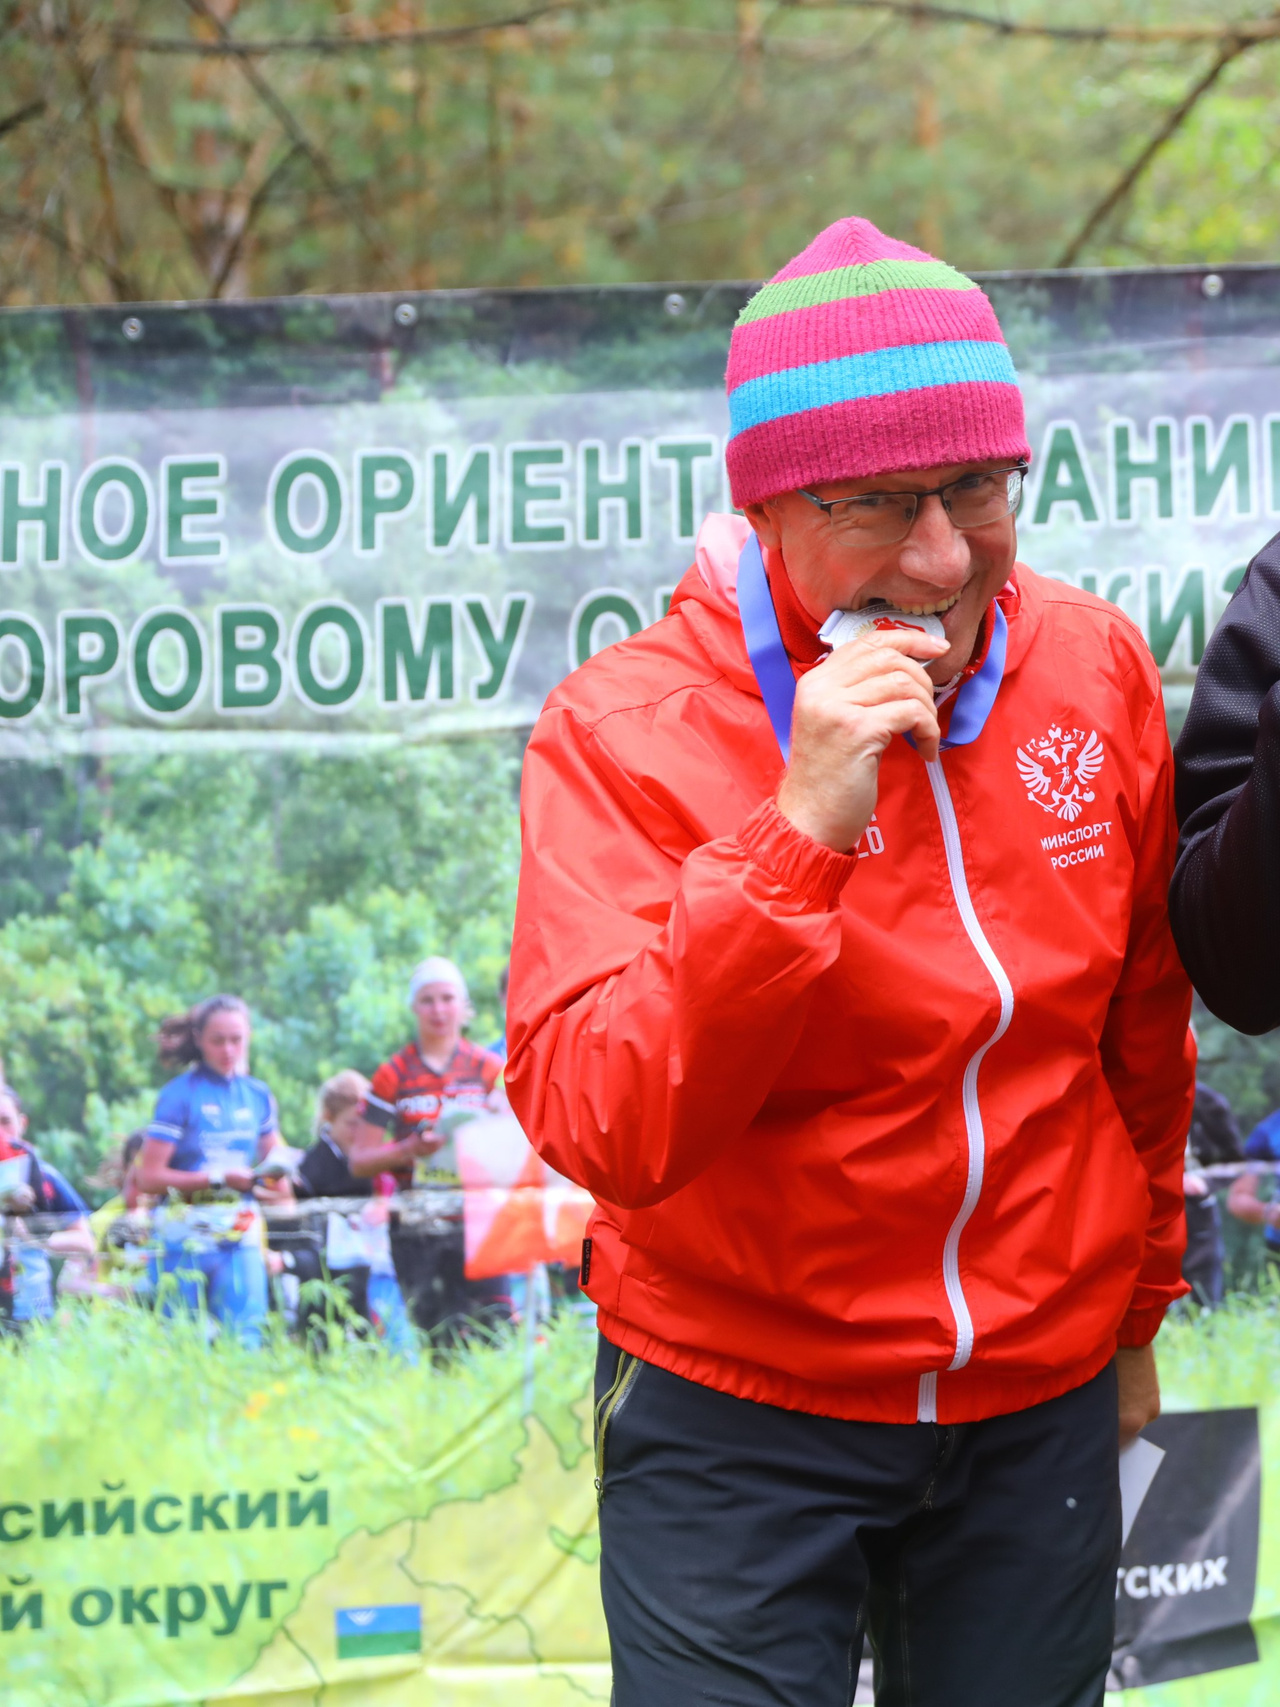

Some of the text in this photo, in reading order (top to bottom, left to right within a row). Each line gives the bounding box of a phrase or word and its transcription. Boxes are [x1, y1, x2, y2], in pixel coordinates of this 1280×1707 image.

[1, 461, 223, 564] НОЕ
[1040, 821, 1112, 851] МИНСПОРТ
[1050, 843, 1105, 870] РОССИИ
[0, 1471, 329, 1542] сийский
[69, 1579, 289, 1637] округ
